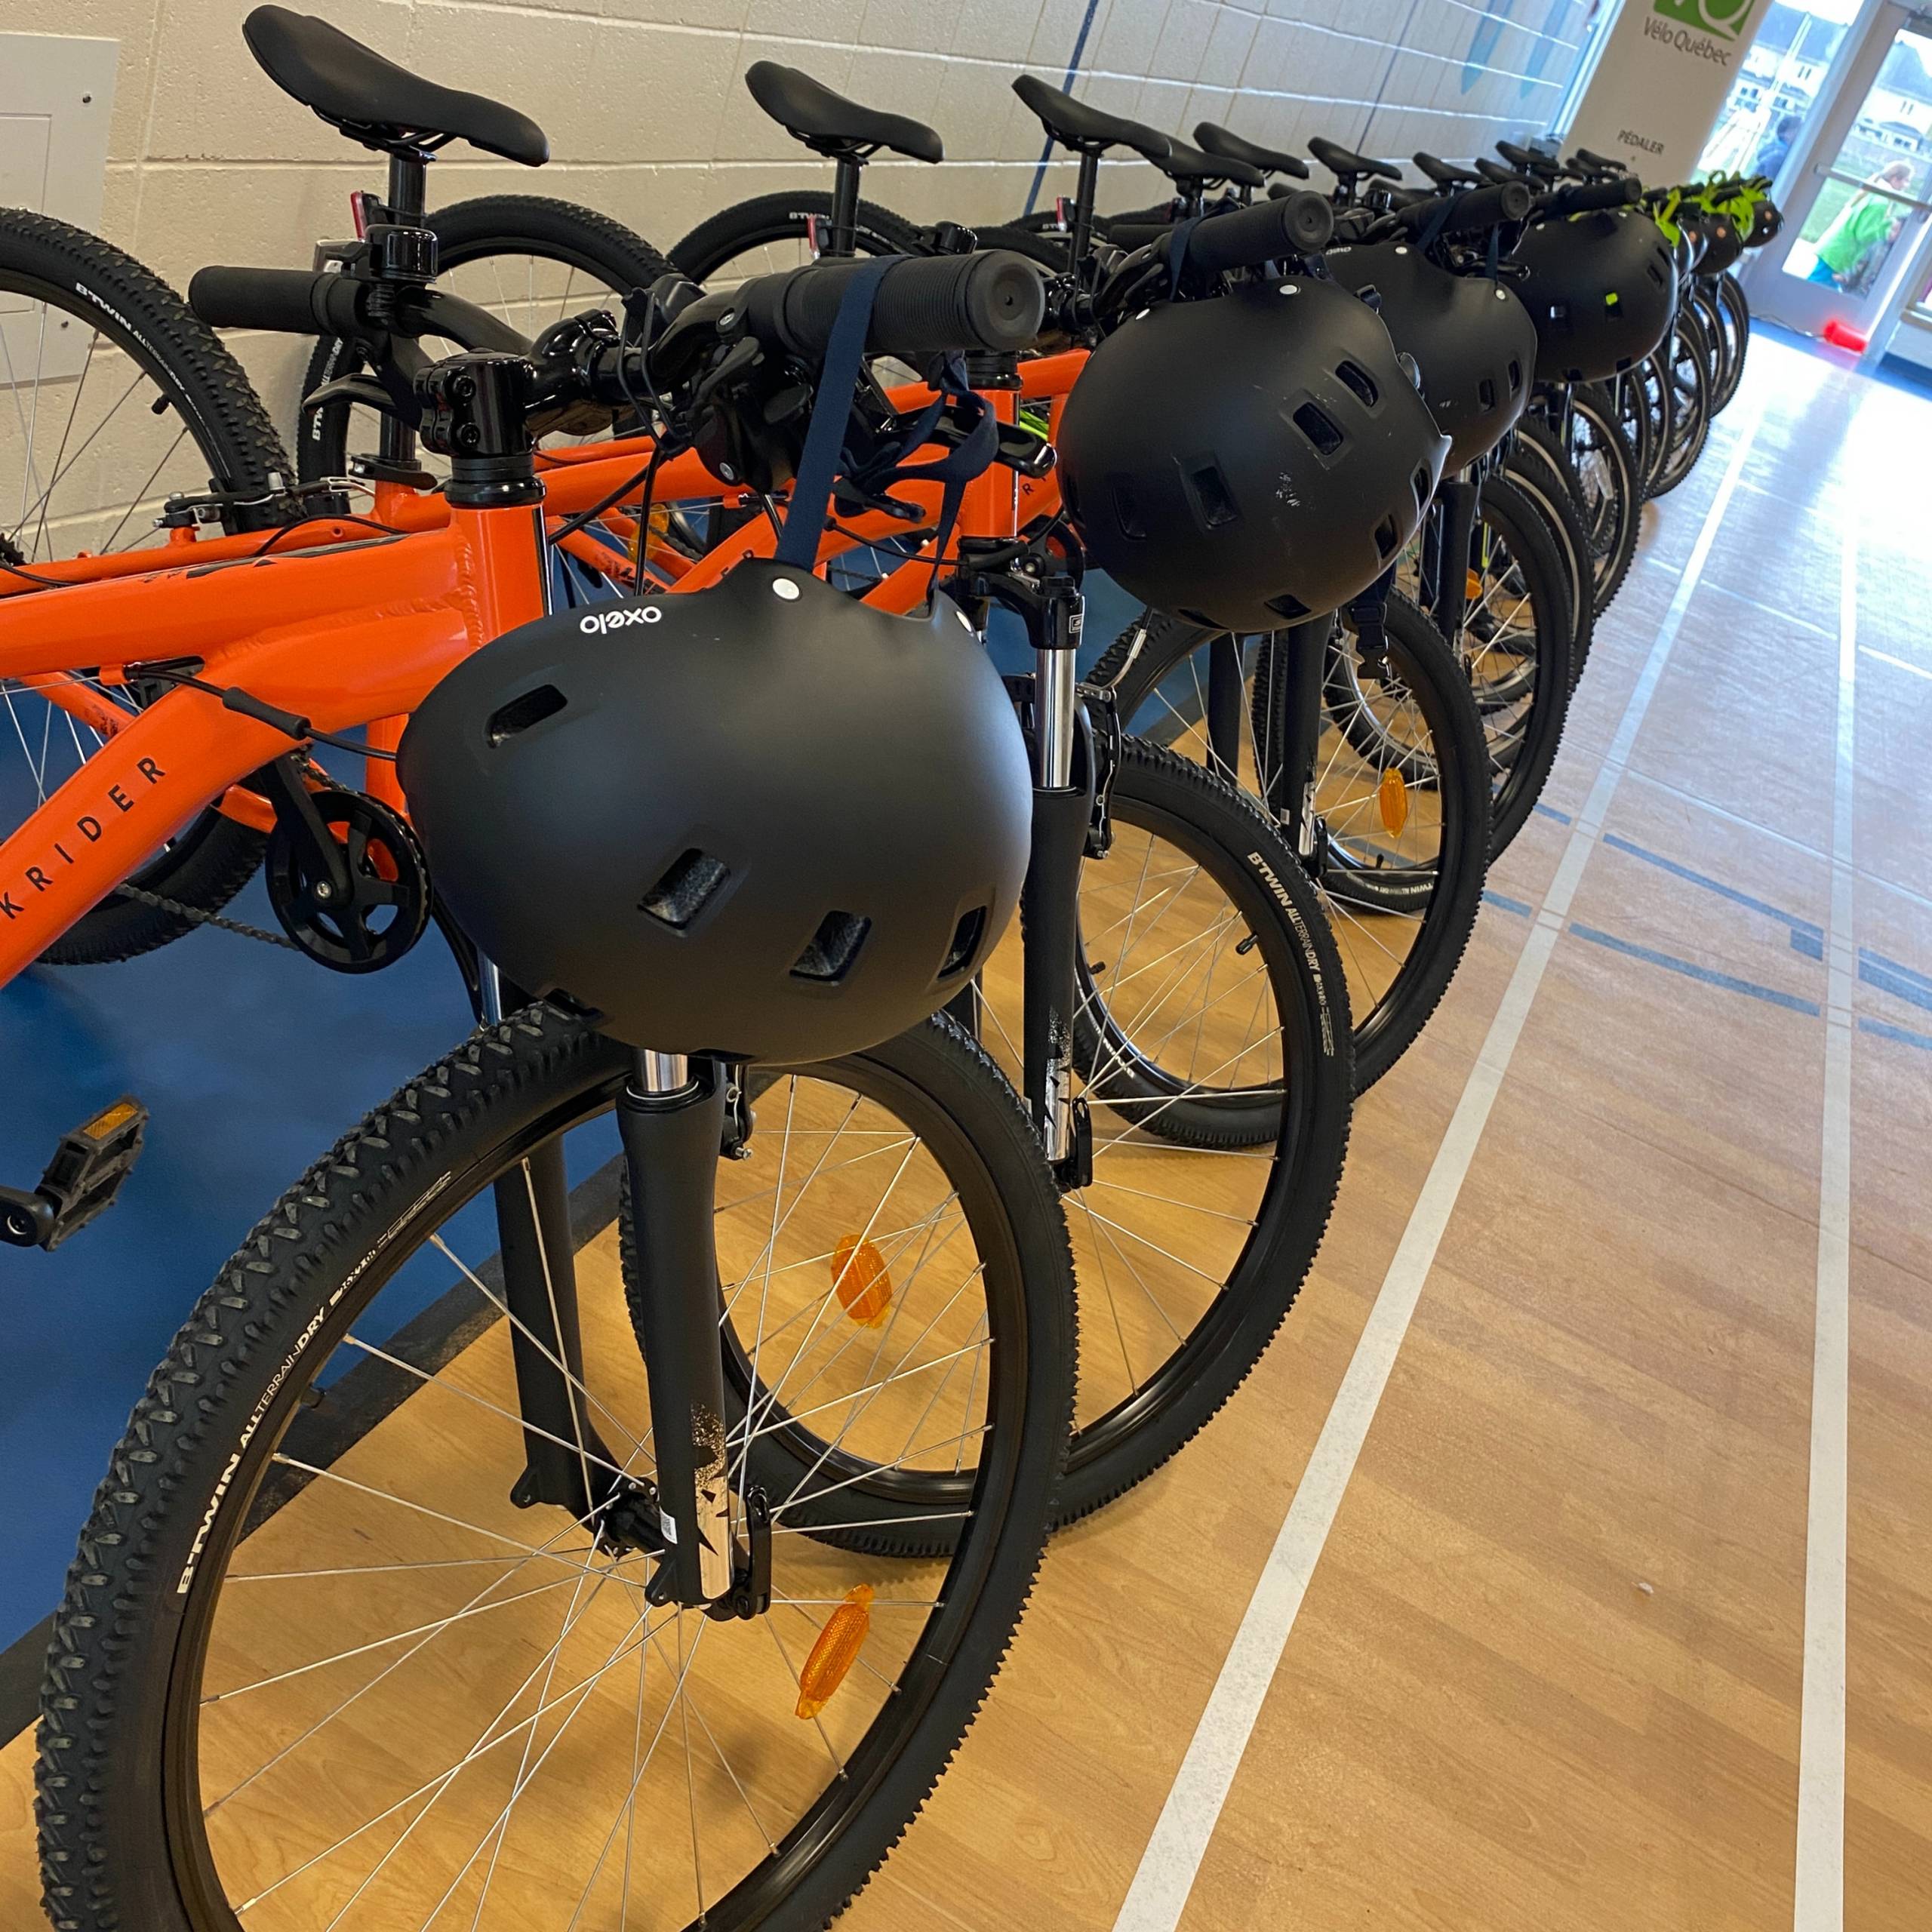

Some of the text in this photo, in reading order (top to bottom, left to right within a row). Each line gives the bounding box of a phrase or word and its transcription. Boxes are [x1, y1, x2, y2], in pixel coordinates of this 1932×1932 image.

[1644, 16, 1732, 66] Vélo Québec
[1617, 129, 1665, 155] PÉDALER
[580, 606, 662, 634] oxelo
